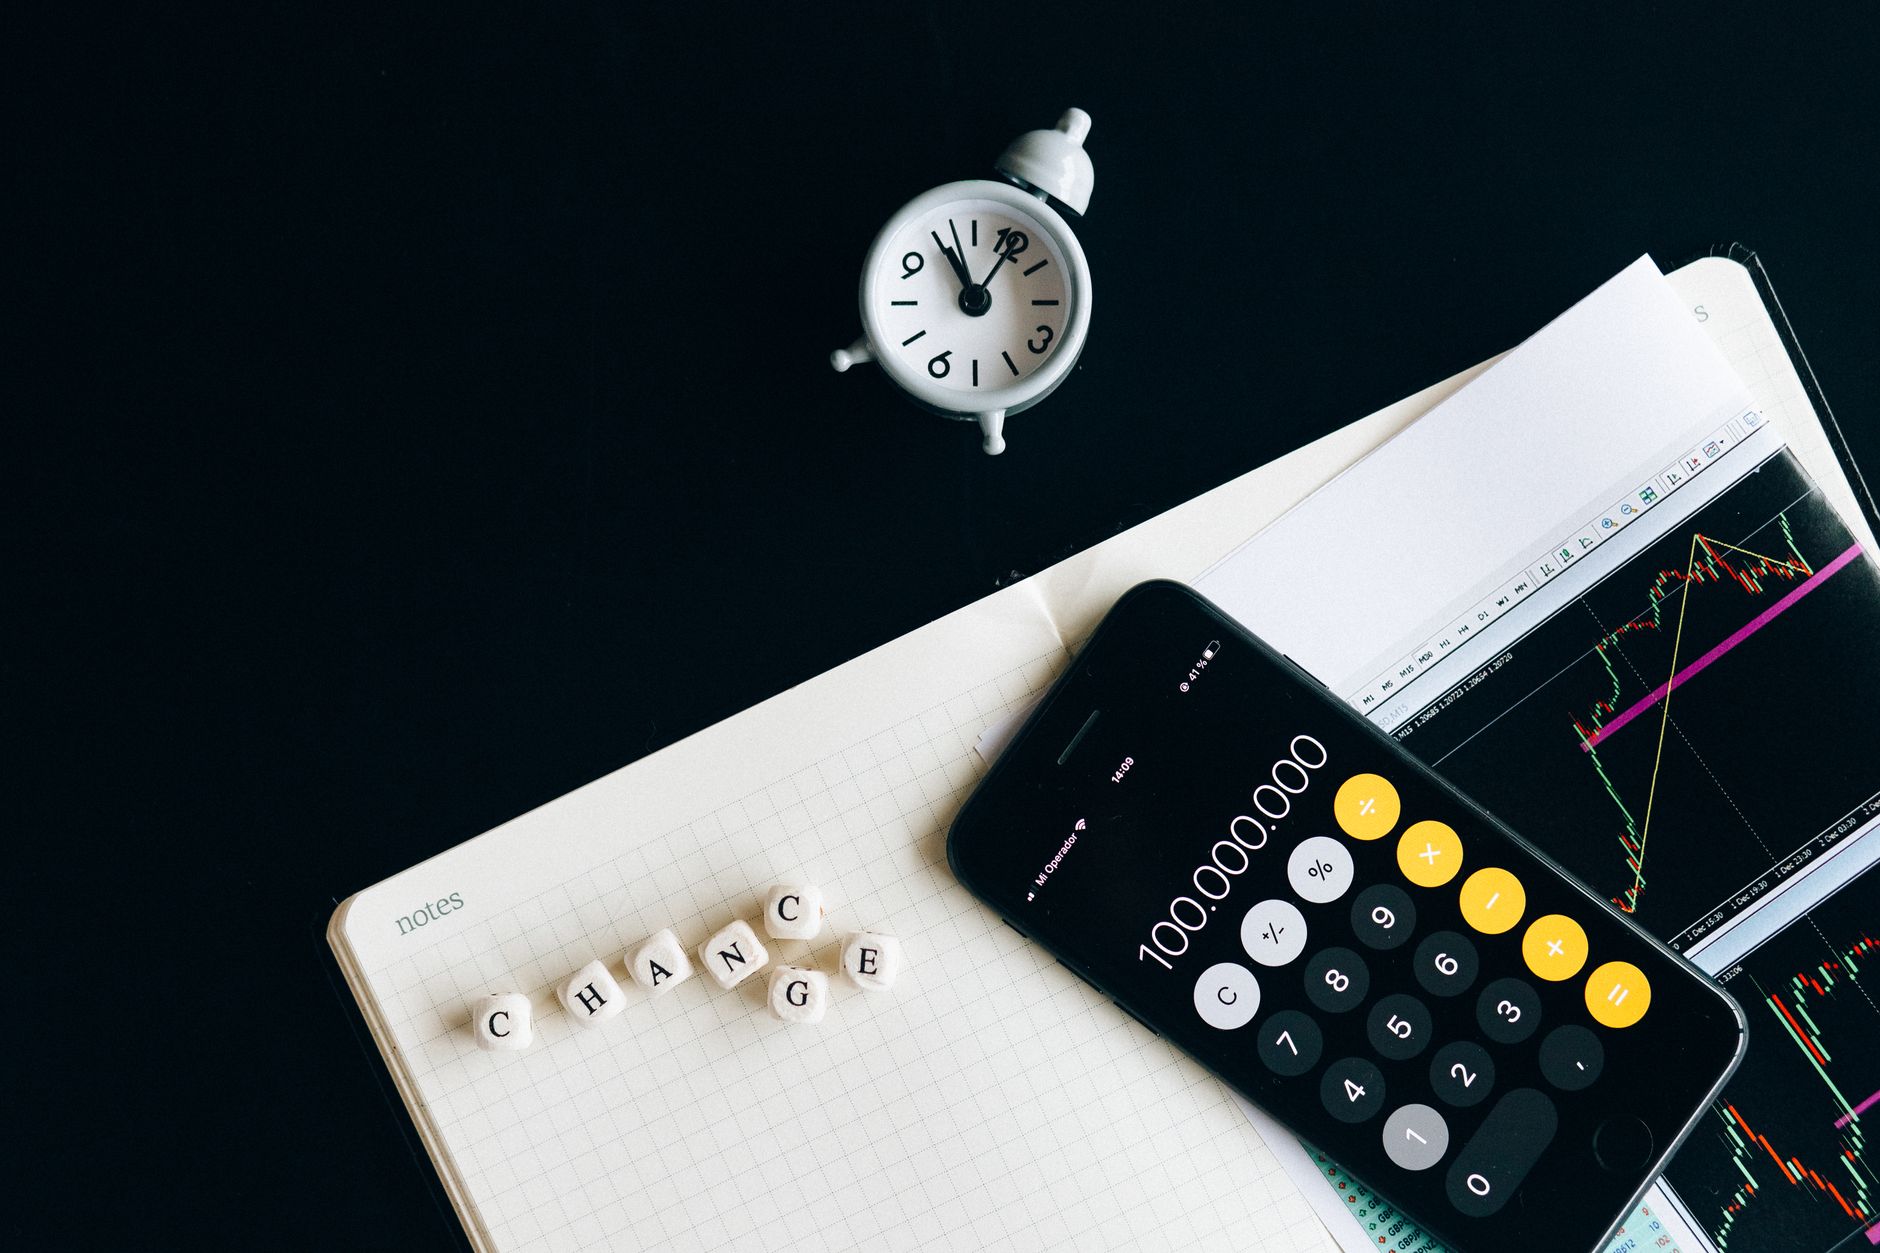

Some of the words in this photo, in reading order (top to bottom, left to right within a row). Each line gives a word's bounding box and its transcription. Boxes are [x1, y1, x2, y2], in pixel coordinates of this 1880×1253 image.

[901, 251, 925, 280] 9
[1028, 324, 1054, 354] 3
[927, 350, 953, 379] 6
[1363, 694, 1375, 706] M1
[1399, 664, 1415, 678] M15
[1111, 756, 1134, 783] 14:09
[1035, 872, 1048, 887] Mi
[1044, 832, 1078, 874] Operador
[1139, 734, 1328, 970] 100.000.000
[395, 892, 465, 936] notes
[1371, 906, 1396, 929] 9
[1434, 952, 1459, 976] 6
[1325, 969, 1350, 992] 8
[1217, 986, 1238, 1006] C
[1497, 1000, 1521, 1023] 3
[1386, 1014, 1412, 1039] 5
[1275, 1030, 1298, 1056] 7
[1450, 1063, 1477, 1088] 2
[1343, 1078, 1366, 1103] 4
[1405, 1127, 1428, 1145] 1
[1466, 1173, 1491, 1196] 0
